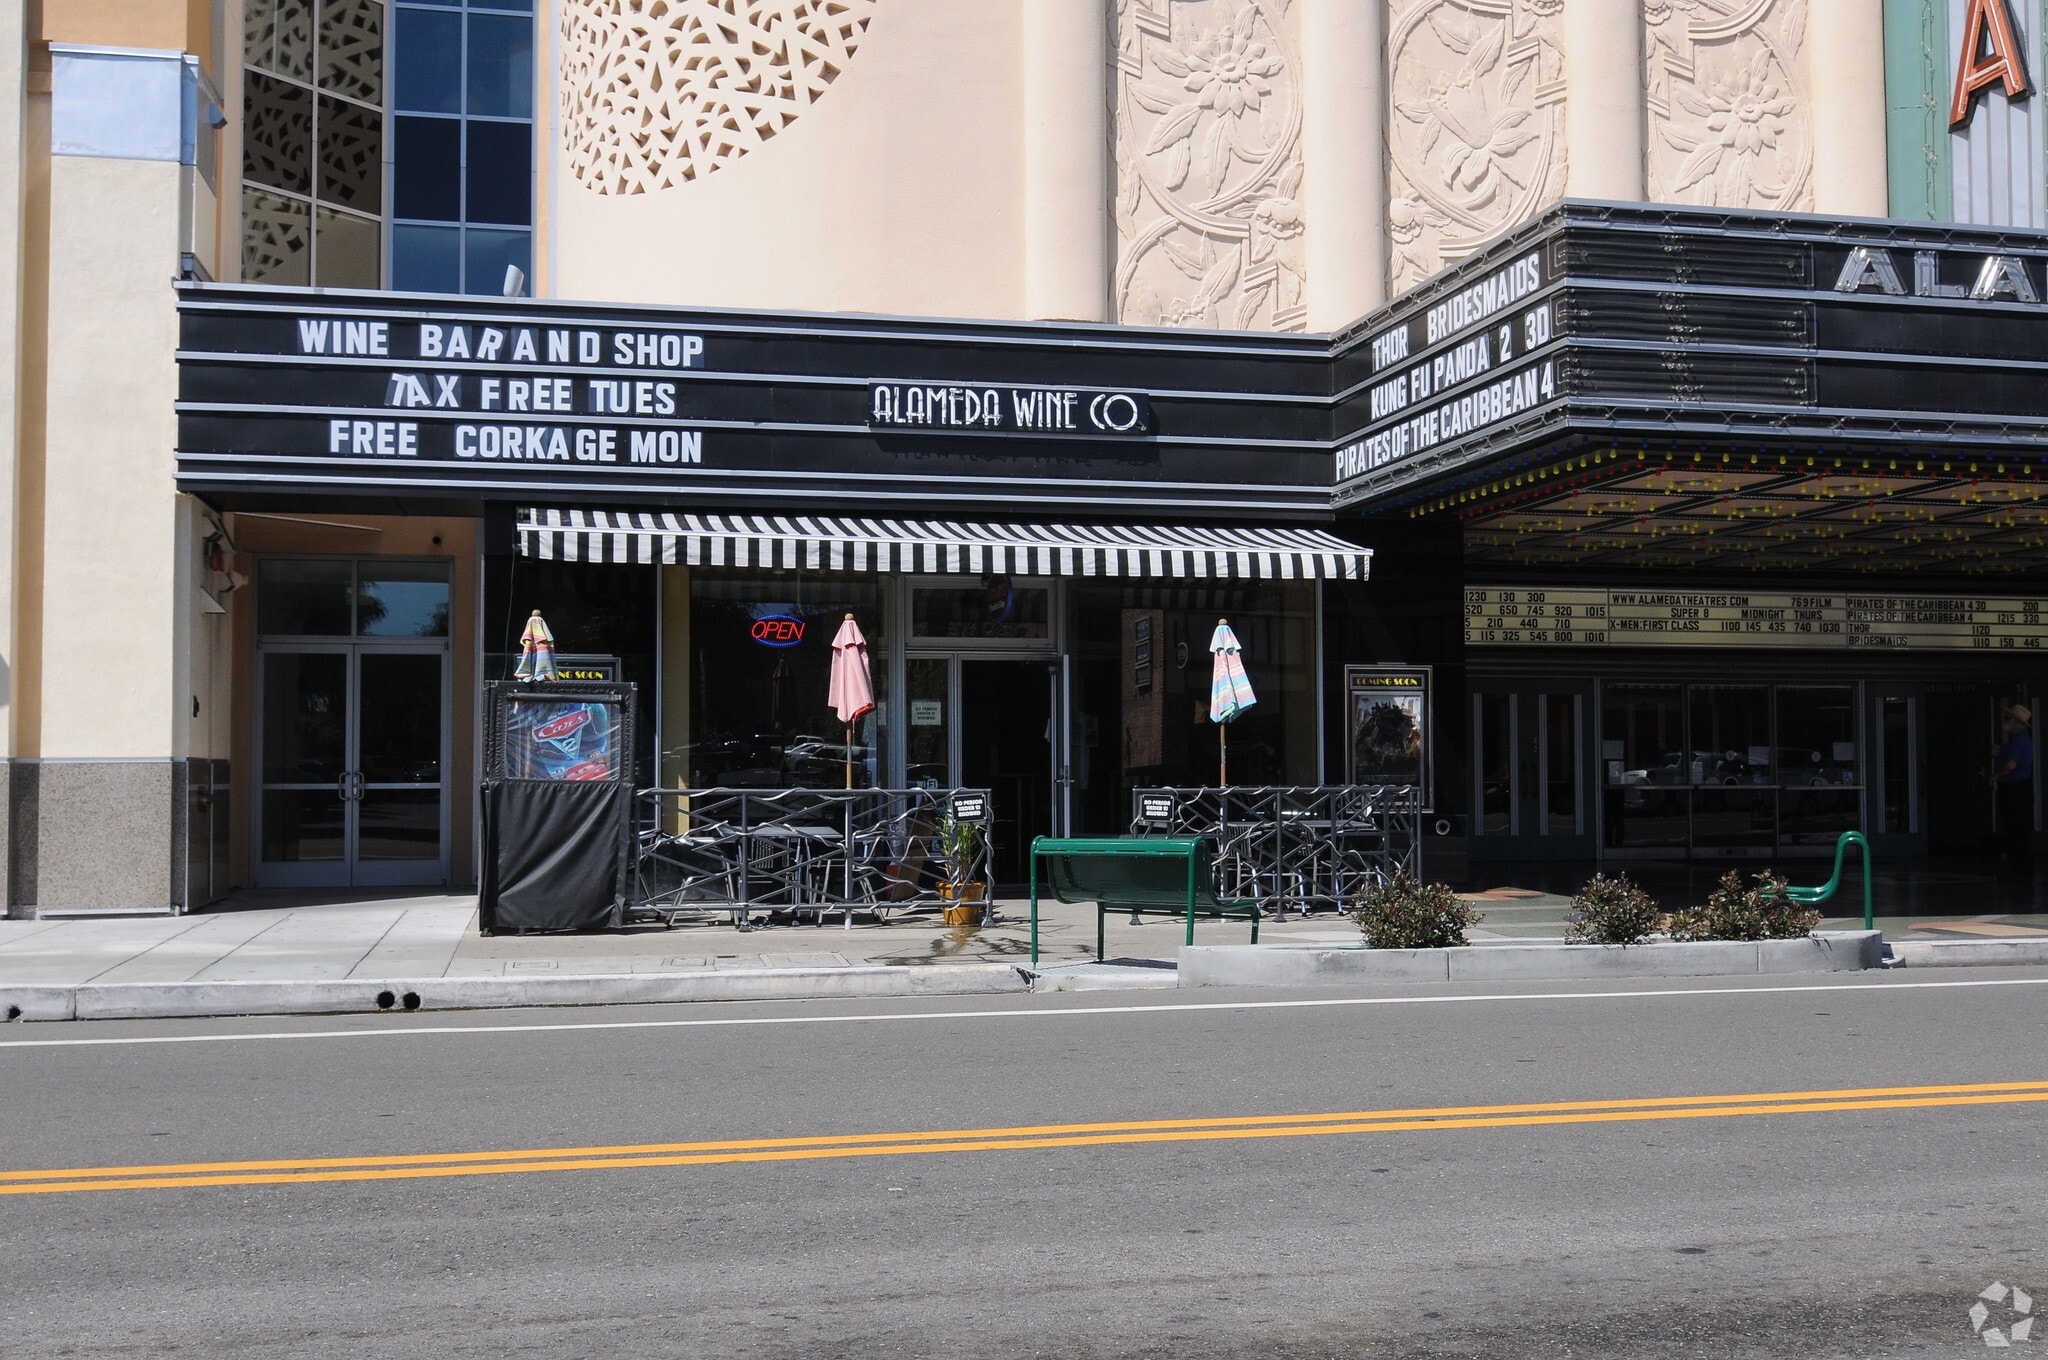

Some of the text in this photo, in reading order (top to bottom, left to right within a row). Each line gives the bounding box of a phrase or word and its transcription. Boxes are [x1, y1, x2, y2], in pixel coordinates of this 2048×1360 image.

[1834, 246, 2048, 303] ALA
[1372, 253, 1540, 372] THOR BRIDESMAIDS
[299, 319, 389, 356] WINE
[614, 332, 703, 368] SHOP
[1371, 305, 1550, 421] KUNG FU PANDA 2 3D
[391, 371, 676, 416] TAX FREE TUES
[873, 385, 1139, 432] ALAMEDA WINE CO
[1336, 361, 1554, 482] PIRATES OF THE CARIBBEAN 4
[330, 419, 702, 464] FREE CORKAGE MON
[1465, 591, 1545, 603] 1230 130 300
[1612, 594, 1636, 604] WWW
[1638, 595, 1727, 606] ALAMEDATHEATRES
[1730, 596, 1749, 606] COM
[1465, 604, 1605, 616] 520 650 745 920 1015
[1848, 599, 1884, 608] PIRATES
[1886, 600, 1898, 609] OF
[1900, 600, 1916, 609] THE
[1917, 600, 1966, 610] CARIBBEAN
[2022, 602, 2039, 611] 200
[1670, 608, 1822, 620] SUPER 8 MIDNIGHT THURS
[1848, 611, 1884, 621] PIRATES
[1886, 612, 1898, 621] OF
[1917, 612, 1966, 622] CARIBBEAN
[1968, 613, 1973, 622] 4
[1998, 614, 2016, 623] 1215
[2023, 614, 2040, 624] 330
[1487, 618, 1504, 628] 210
[1520, 618, 1538, 628] 440
[1554, 619, 1570, 629] 710
[1672, 620, 1700, 631] CLASS
[1721, 622, 1740, 631] 1100
[1746, 622, 1761, 632] 145
[1768, 622, 1786, 632] 435
[1794, 622, 1811, 632] 740
[1820, 623, 1840, 633] 1030
[1848, 624, 1990, 635] THOR 1120
[750, 620, 808, 641] OPEN
[1480, 631, 1494, 641] 115
[1502, 632, 1520, 641] 325
[1530, 632, 1548, 642] 545
[1554, 632, 1572, 642] 800
[1584, 632, 1604, 642] 1010
[1974, 638, 1990, 648] 1110
[2000, 638, 2014, 648] 150
[2024, 638, 2040, 648] 445
[575, 670, 604, 680] SOON
[1356, 678, 1418, 686] COMING SOON
[538, 716, 584, 738] Cars
